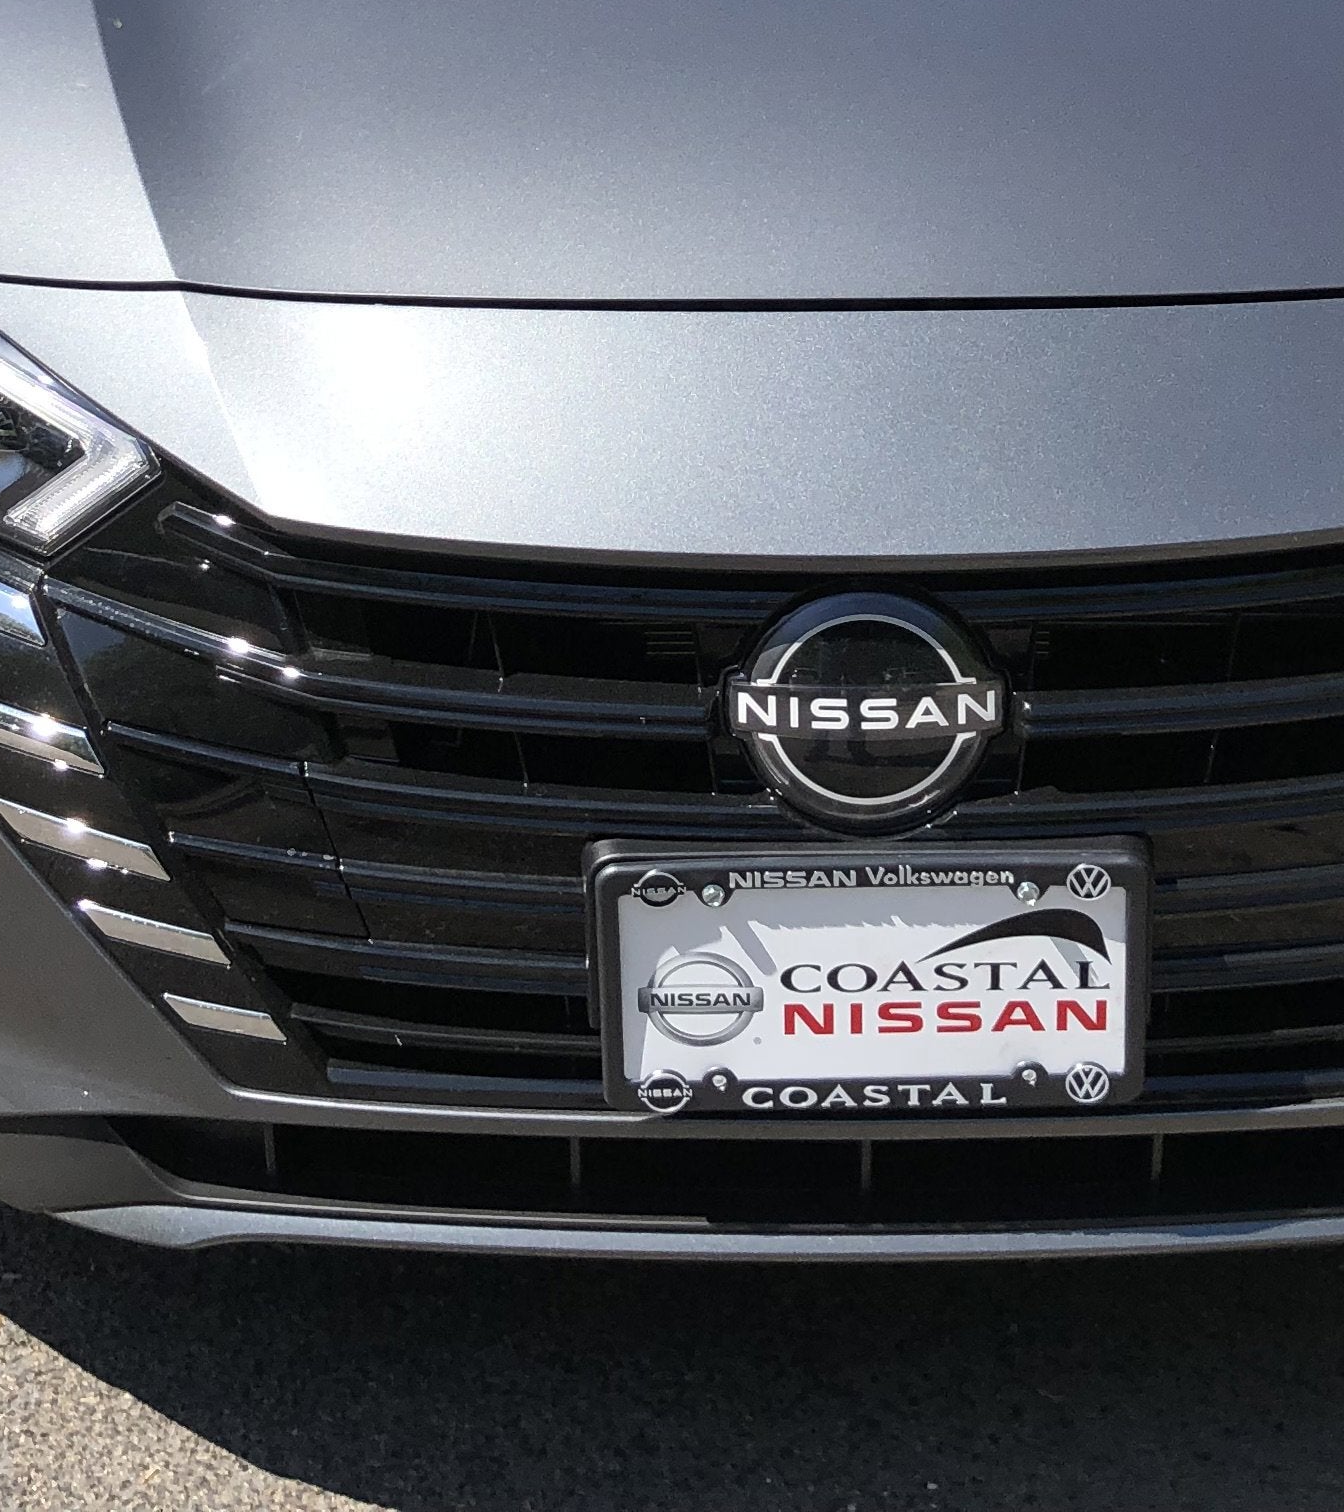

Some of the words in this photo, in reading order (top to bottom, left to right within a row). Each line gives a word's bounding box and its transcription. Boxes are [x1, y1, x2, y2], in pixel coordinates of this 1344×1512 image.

[736, 689, 997, 730] NISSAN
[728, 869, 857, 888] NISSAN
[865, 865, 1015, 887] Volkswagen
[780, 959, 1111, 993] COASTAL
[650, 992, 751, 1007] NISSAN
[783, 1000, 1108, 1035] NISSAN
[742, 1082, 1007, 1108] COASTAL
